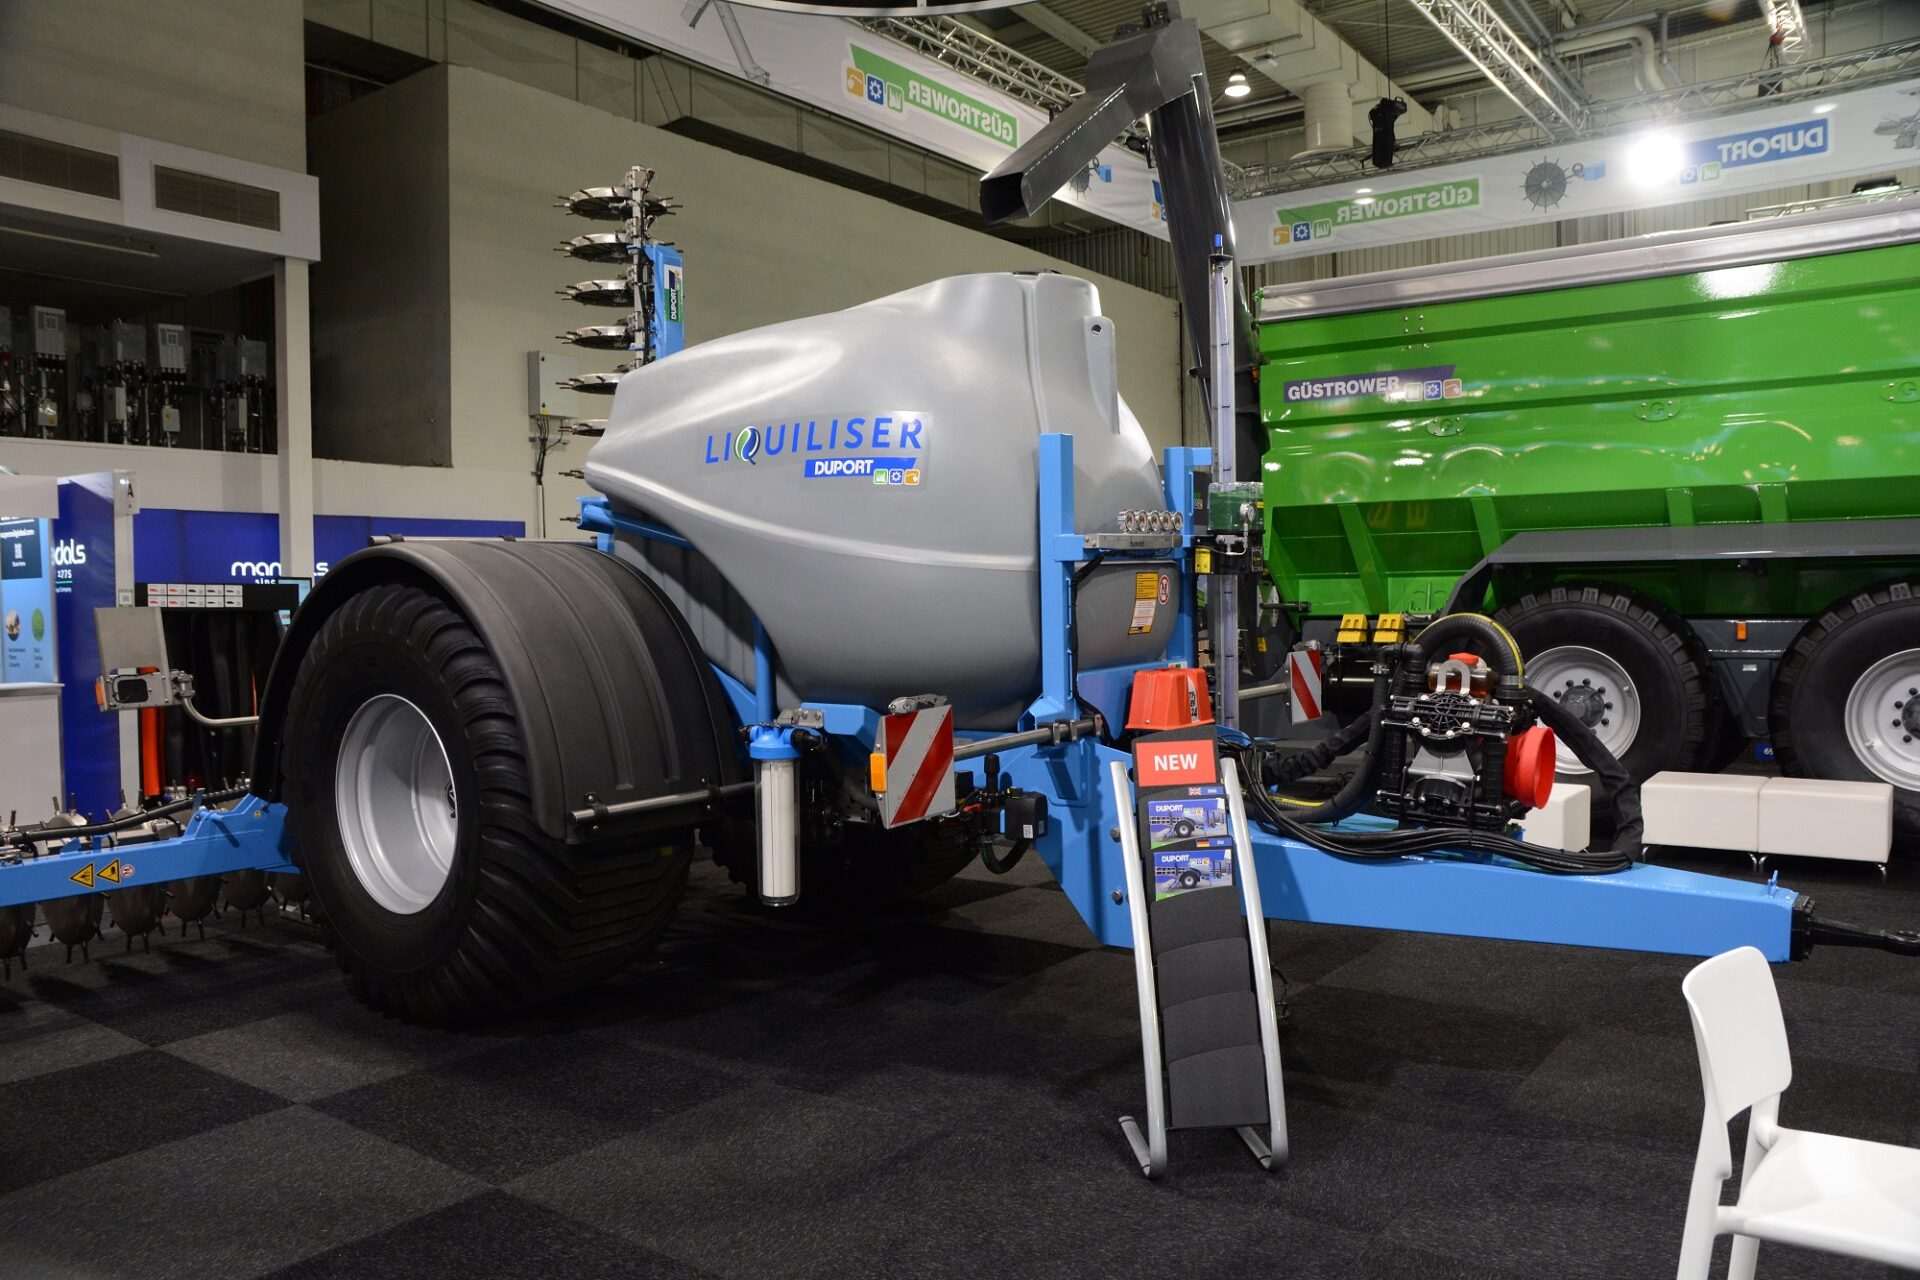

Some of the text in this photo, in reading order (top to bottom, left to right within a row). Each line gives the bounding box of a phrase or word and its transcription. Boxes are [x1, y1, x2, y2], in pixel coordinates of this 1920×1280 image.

[1287, 375, 1400, 401] GÜSTROWER
[705, 416, 924, 466] LIQUILISER
[814, 459, 874, 476] DUPORT
[1153, 753, 1198, 771] NEW
[1155, 804, 1183, 812] DUPORT
[1161, 854, 1189, 862] DUPORT
